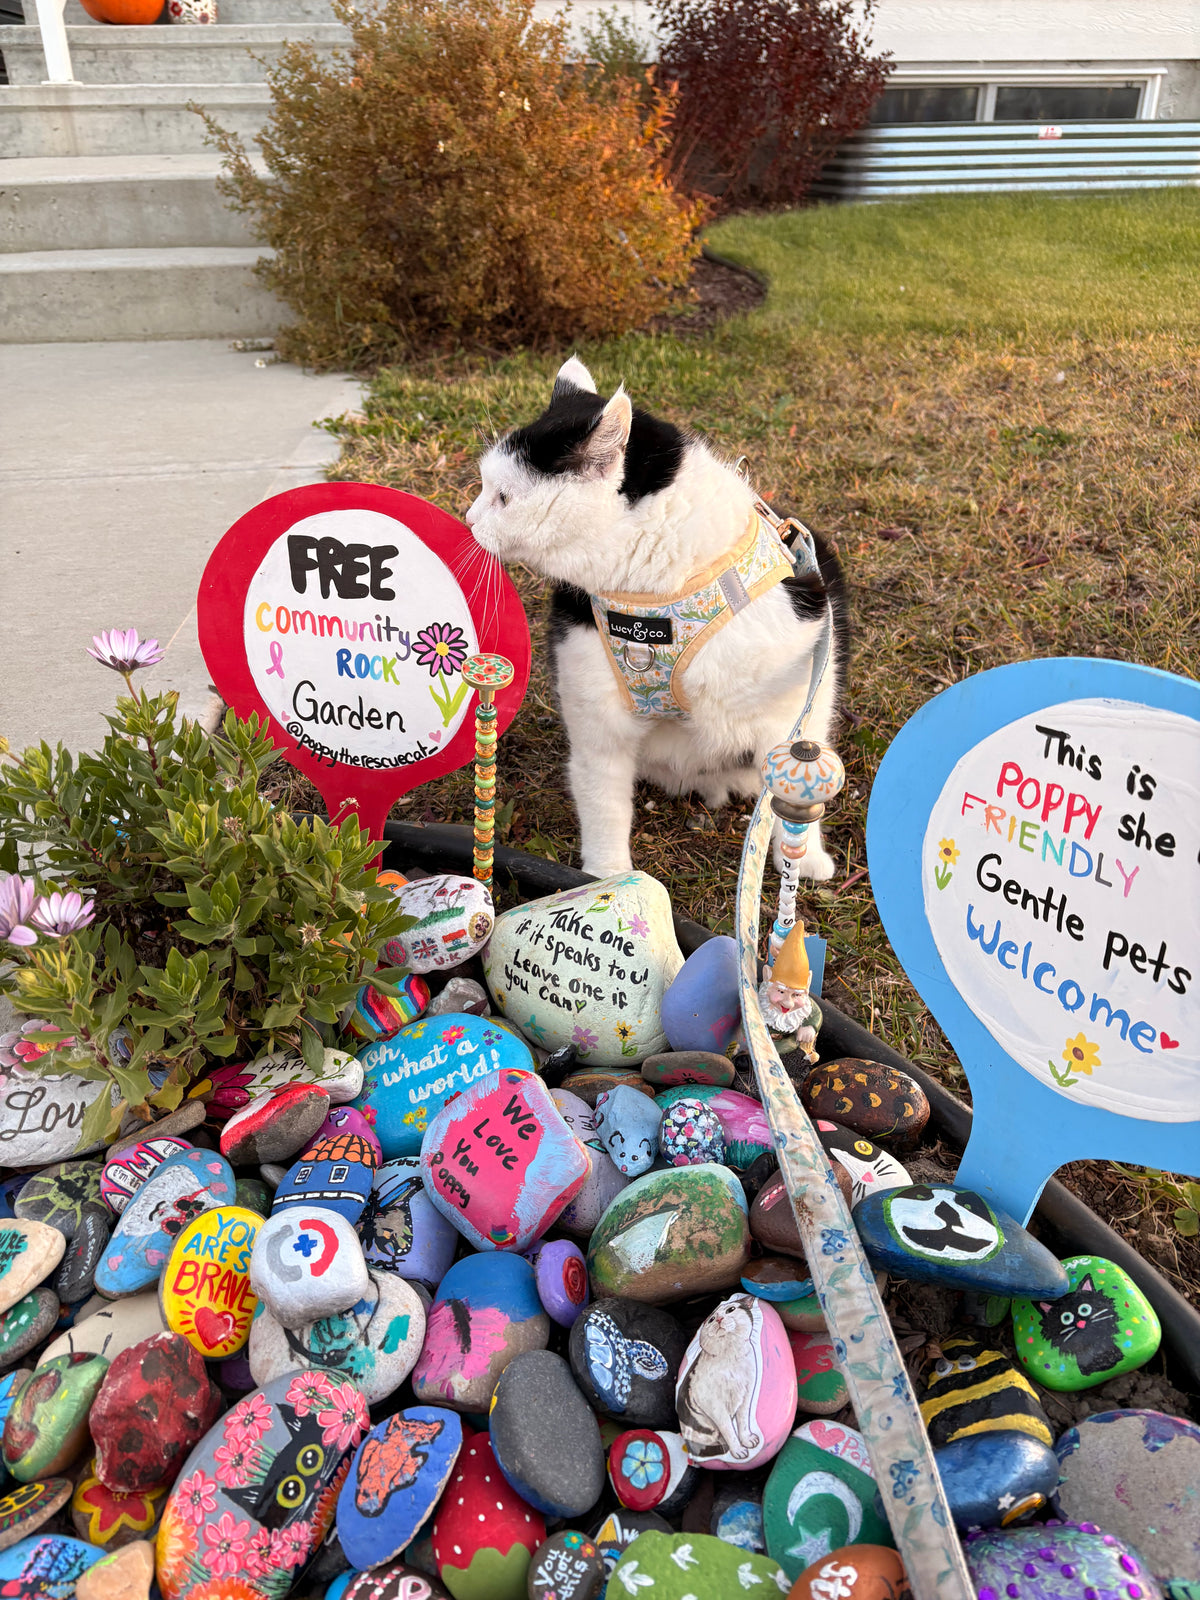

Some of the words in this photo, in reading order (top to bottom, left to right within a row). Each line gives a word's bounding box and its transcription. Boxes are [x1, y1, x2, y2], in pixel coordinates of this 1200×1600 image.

[287, 534, 400, 601] FREE
[611, 623, 633, 636] LUCY
[633, 621, 648, 641] &
[648, 630, 667, 638] CO.
[336, 648, 400, 685] ROCK
[292, 680, 406, 733] Garden
[286, 721, 438, 768] @poppytherescuecat_
[1035, 724, 1102, 781] This
[1126, 765, 1157, 800] is
[996, 761, 1102, 840] POPPY
[1118, 811, 1176, 858] she
[961, 791, 1140, 898] FRIENDLY
[515, 918, 531, 935] if
[529, 923, 545, 946] it
[544, 934, 601, 972] speaks
[608, 959, 626, 980] to
[549, 907, 594, 941] Take
[600, 929, 635, 957] one
[976, 853, 1085, 942] Gentle
[1103, 930, 1192, 995] pets
[513, 948, 561, 987] Leave
[568, 977, 606, 1001] one
[612, 987, 629, 1010] if
[539, 985, 573, 1011] can
[966, 903, 1158, 1054] Welcome
[382, 1044, 448, 1087] what
[456, 1039, 479, 1056] a
[408, 1048, 501, 1104] world!
[0, 1086, 87, 1142] Lov
[502, 1094, 537, 1141] We
[451, 1138, 480, 1177] You
[473, 1118, 520, 1170] Love
[430, 1151, 471, 1209] Poppy
[183, 1232, 232, 1263] ARE
[233, 1250, 252, 1274] S
[172, 1260, 256, 1314] BRAVE
[533, 1548, 561, 1588] You
[554, 1550, 573, 1583] got
[558, 1559, 588, 1600] this
